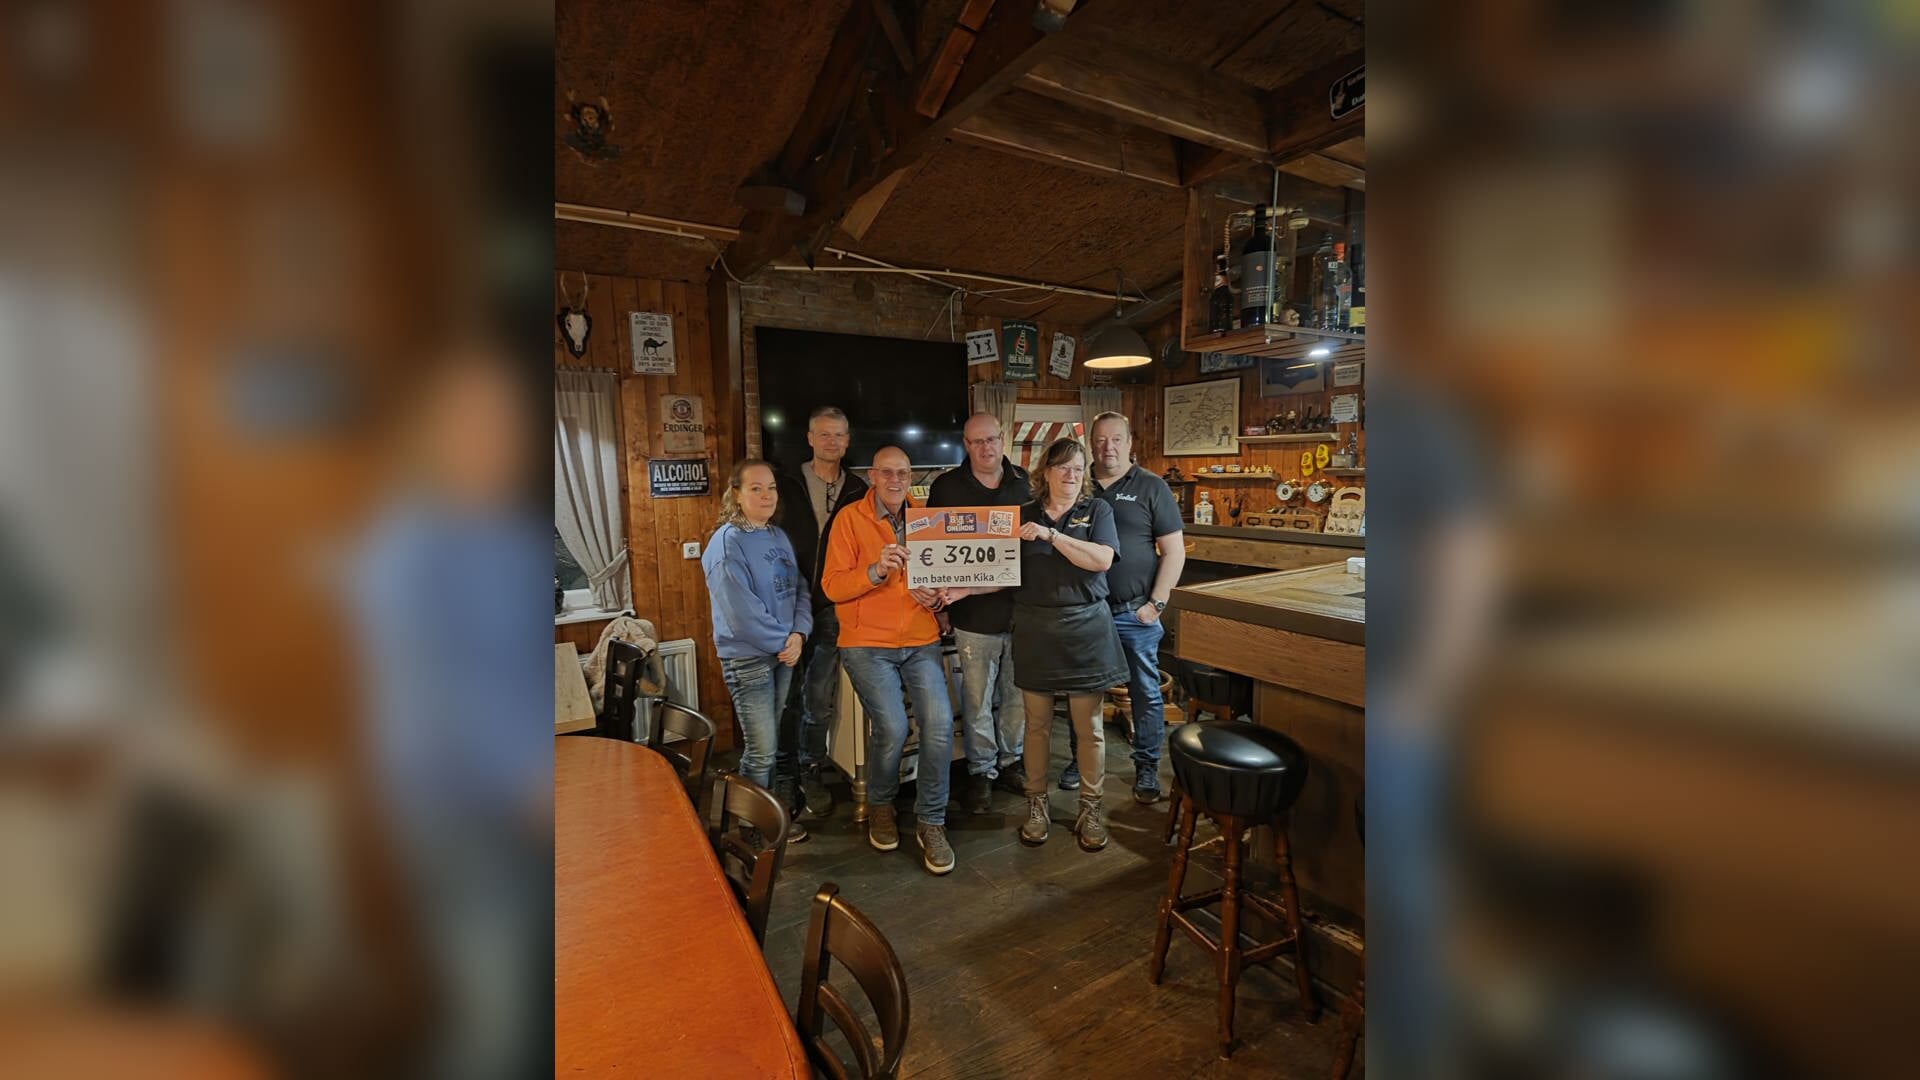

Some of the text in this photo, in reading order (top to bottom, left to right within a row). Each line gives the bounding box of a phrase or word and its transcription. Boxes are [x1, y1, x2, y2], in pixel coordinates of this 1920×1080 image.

[664, 423, 703, 433] ERDINGER
[654, 464, 707, 481] ALCOHOL
[920, 547, 934, 567] €
[912, 573, 995, 584] ten bate van Kika
